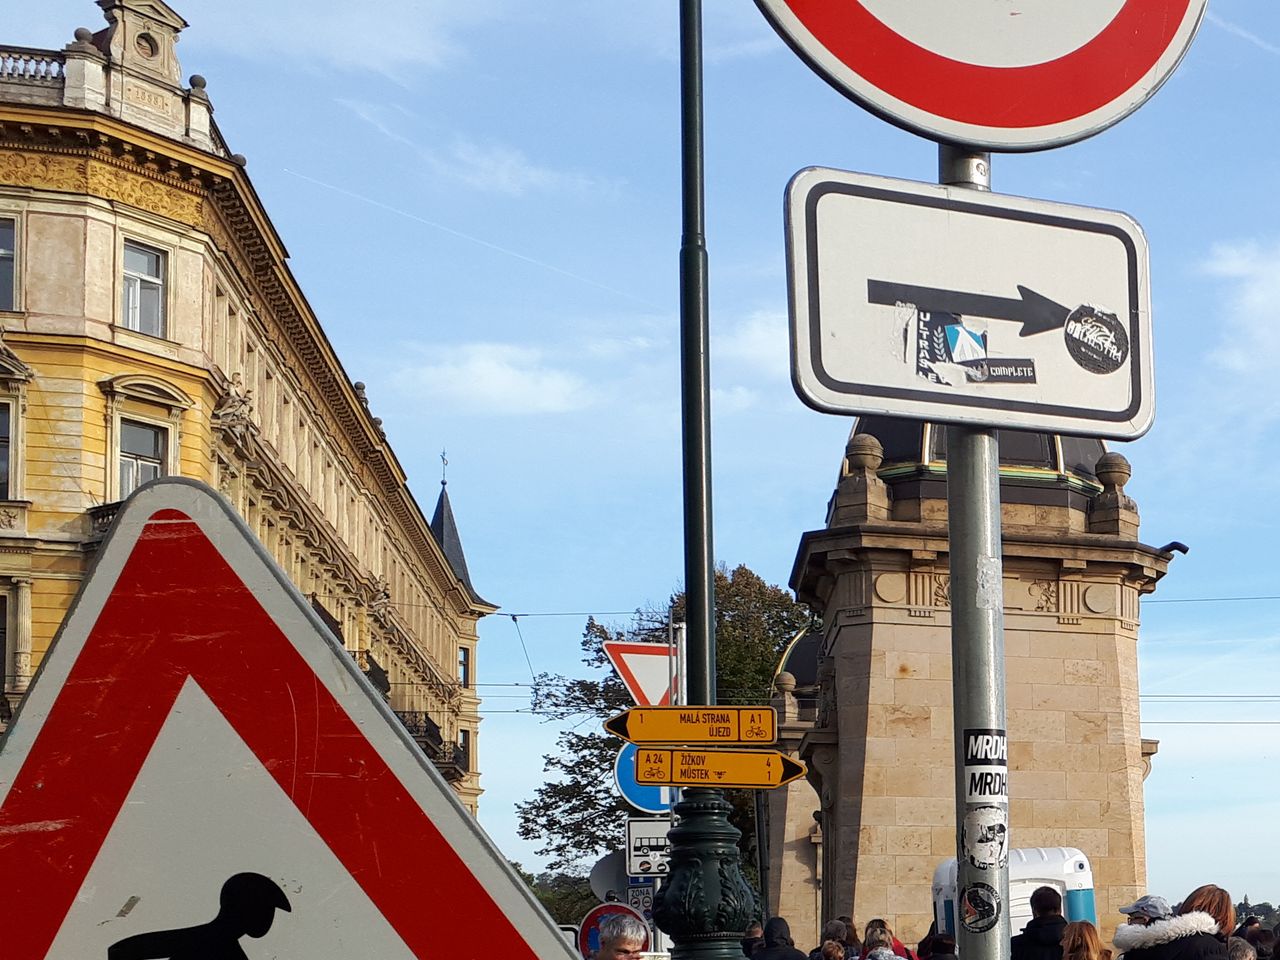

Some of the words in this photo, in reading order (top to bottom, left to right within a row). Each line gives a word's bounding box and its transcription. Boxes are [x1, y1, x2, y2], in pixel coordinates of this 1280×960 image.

[919, 311, 931, 369] ULTRAS
[990, 366, 1034, 378] COMPLETE
[639, 713, 644, 724] 1
[679, 712, 700, 724] MALÁ
[702, 714, 730, 724] STRANA
[750, 714, 756, 724] A
[709, 725, 731, 737] ÚJEZD
[645, 754, 651, 764] A
[653, 754, 663, 764] 24
[680, 754, 706, 766] ŽIŽKOV
[766, 757, 771, 767] 4
[680, 768, 710, 780] MŮSTEK
[767, 771, 771, 781] 1
